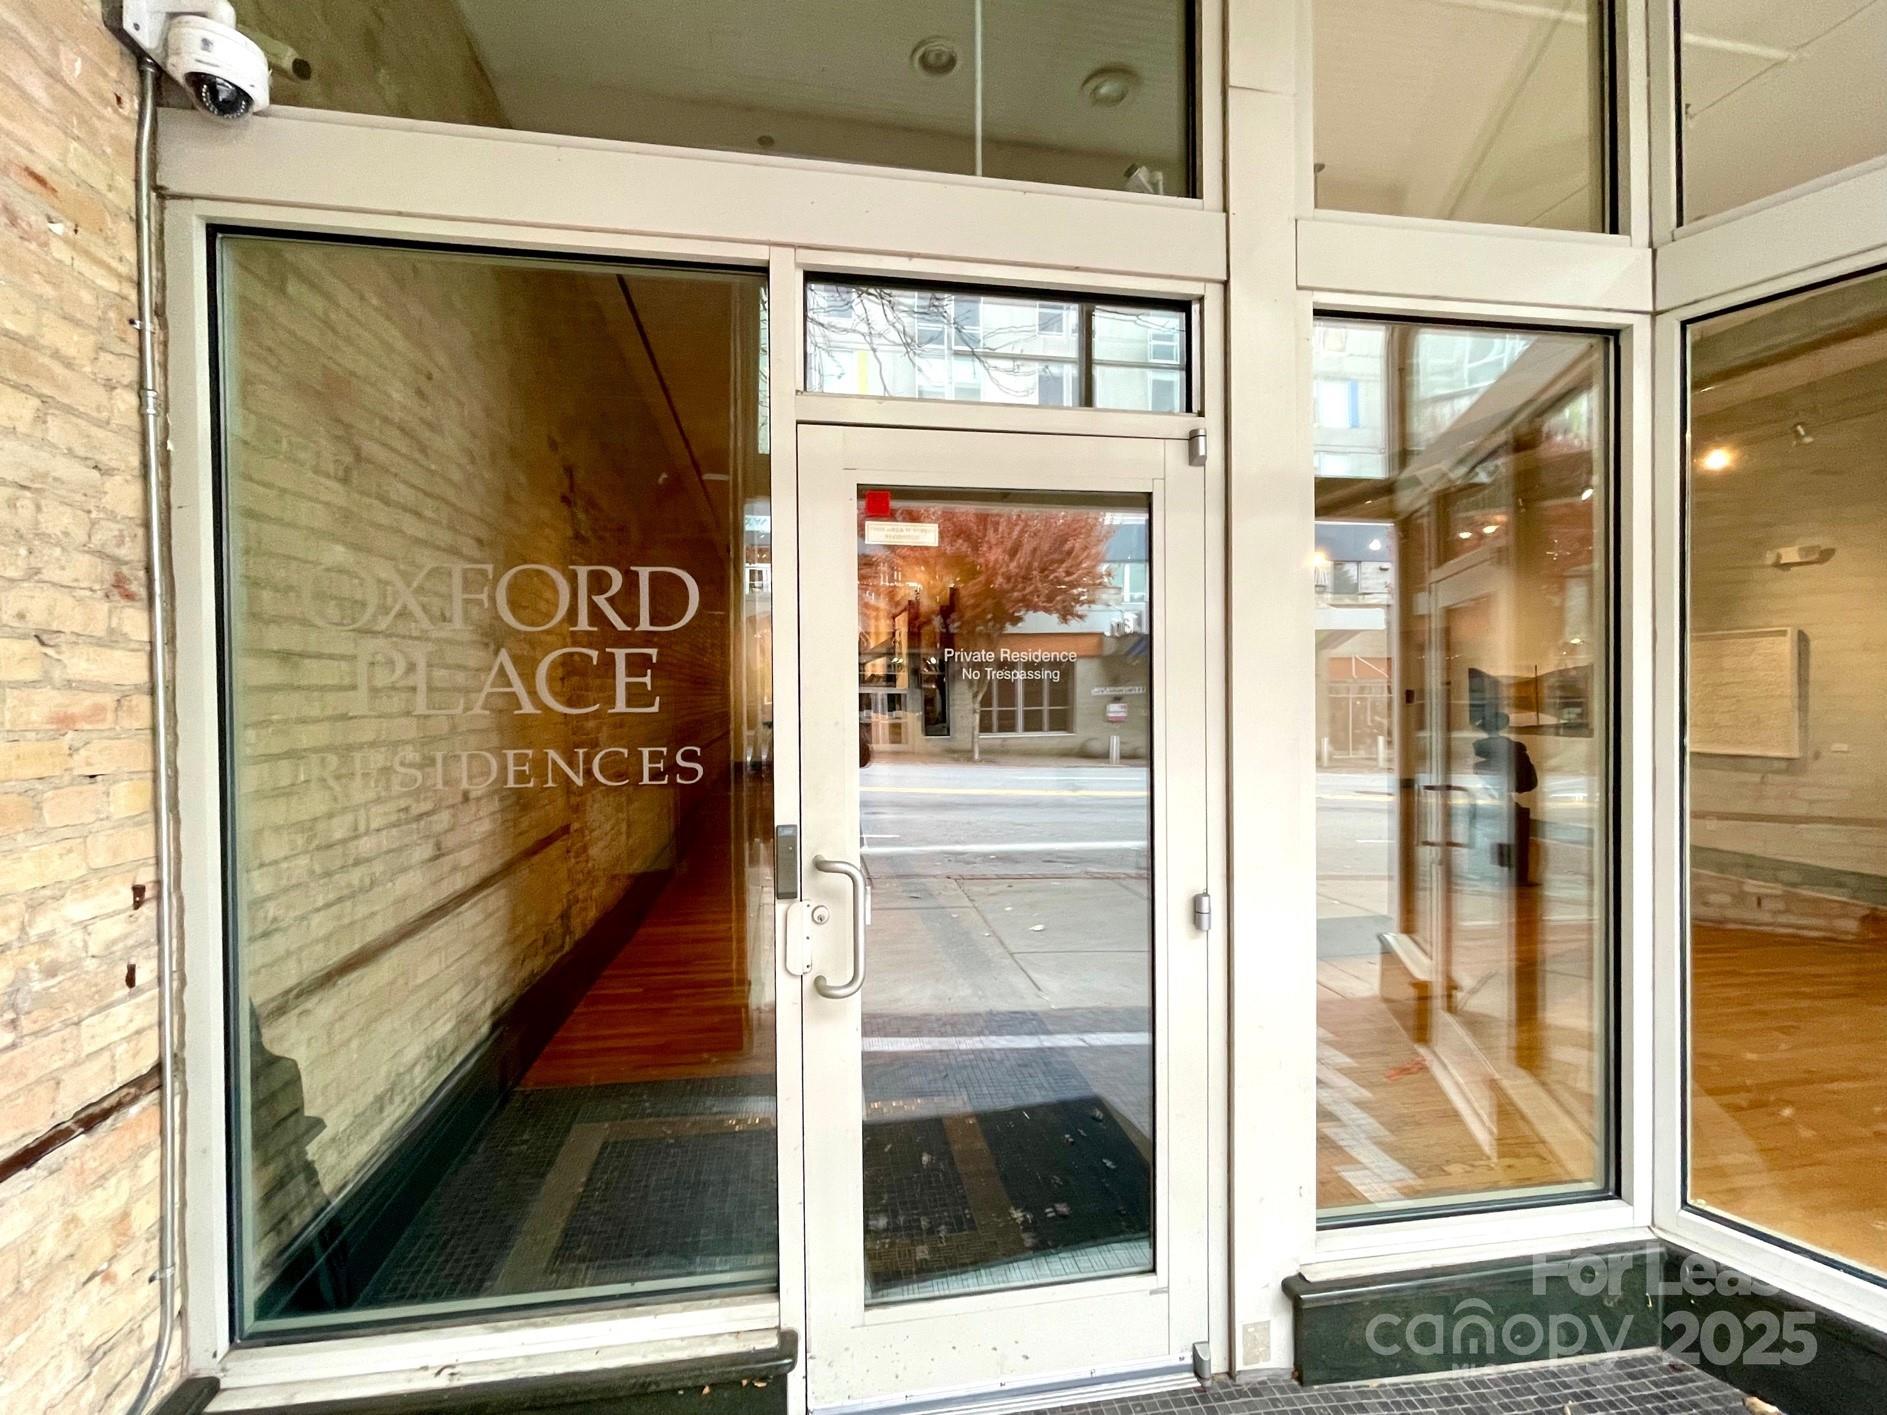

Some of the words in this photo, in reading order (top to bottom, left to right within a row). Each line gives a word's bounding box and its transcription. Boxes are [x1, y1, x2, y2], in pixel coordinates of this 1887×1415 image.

[304, 563, 700, 633] OXFORD
[943, 648, 995, 662] Private
[1000, 648, 1078, 662] Residence
[962, 668, 981, 680] No
[985, 667, 1060, 682] Trespassing
[348, 646, 661, 716] PLACE
[303, 745, 704, 791] RESIDENCES
